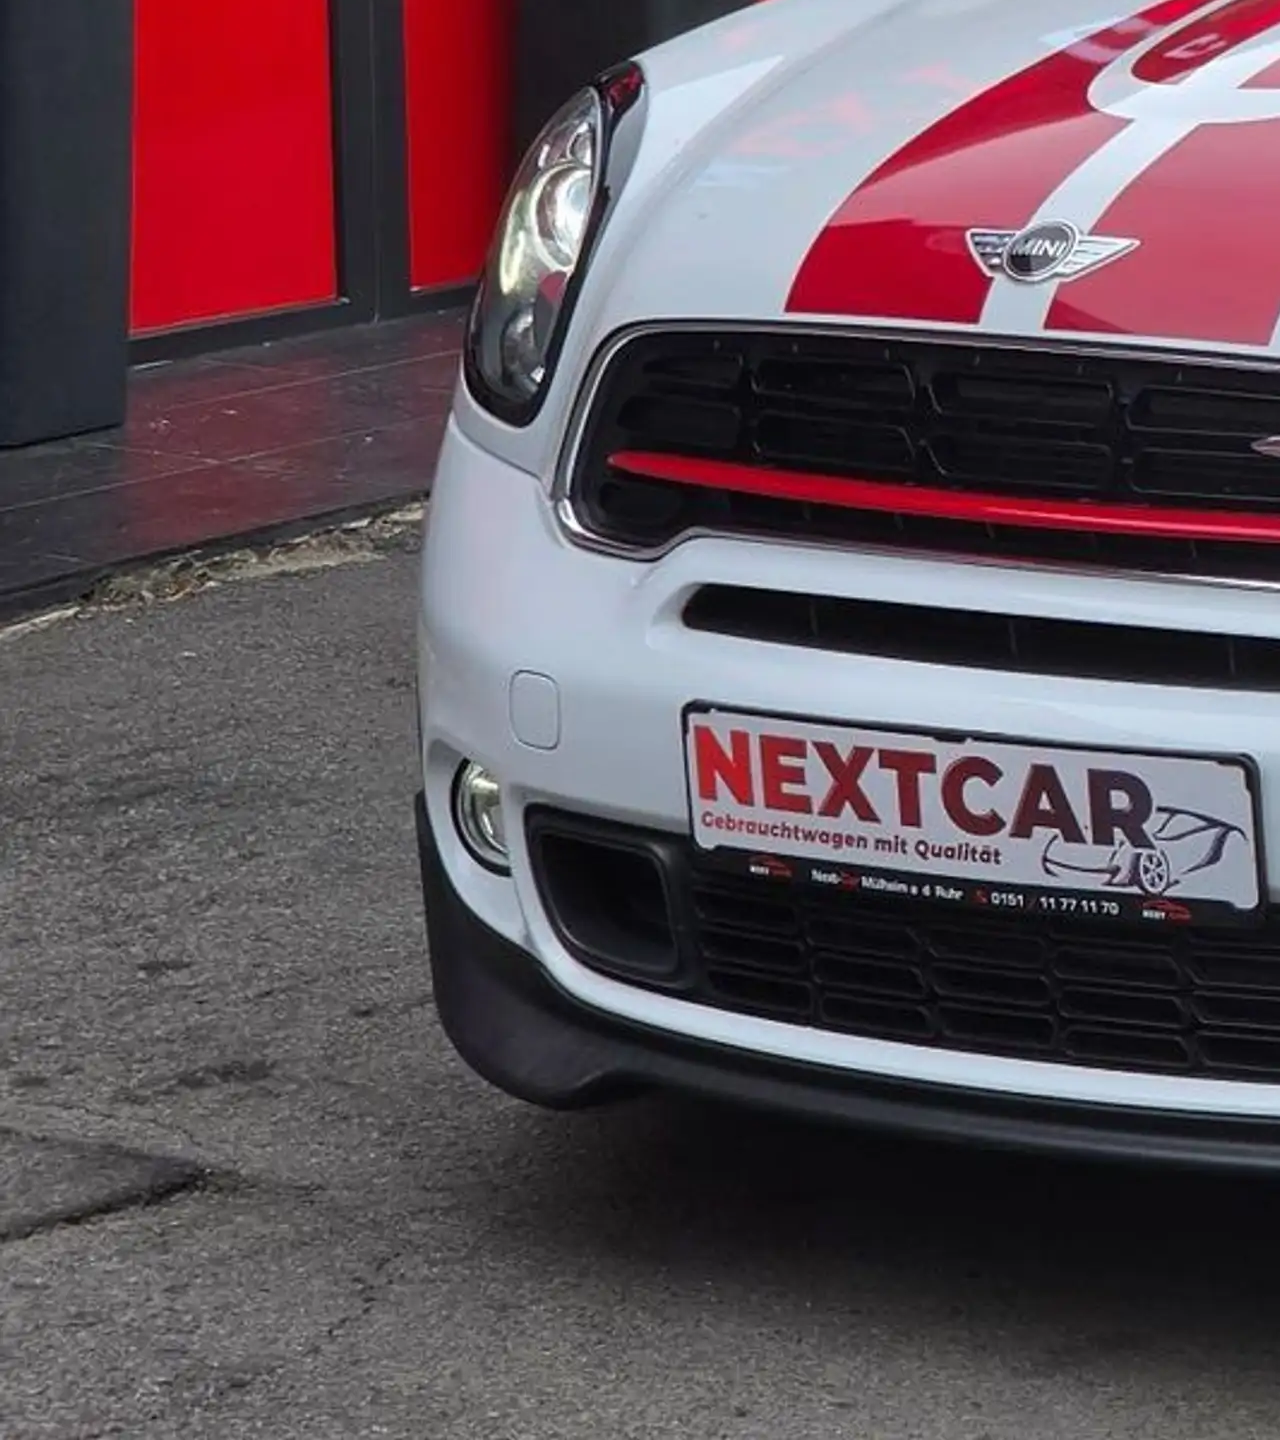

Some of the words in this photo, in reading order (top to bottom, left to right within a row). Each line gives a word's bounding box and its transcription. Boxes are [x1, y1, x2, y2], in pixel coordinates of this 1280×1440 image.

[1012, 238, 1067, 257] MINI
[693, 724, 1157, 849] NEXTCAR
[701, 811, 868, 850] Gebrauchtwagen
[874, 835, 908, 855] mit
[914, 839, 1003, 866] Qualität
[991, 892, 1025, 908] 0151
[1039, 895, 1055, 910] 11
[1060, 897, 1077, 912] 77
[1081, 898, 1097, 914] 11
[1101, 900, 1120, 916] 70
